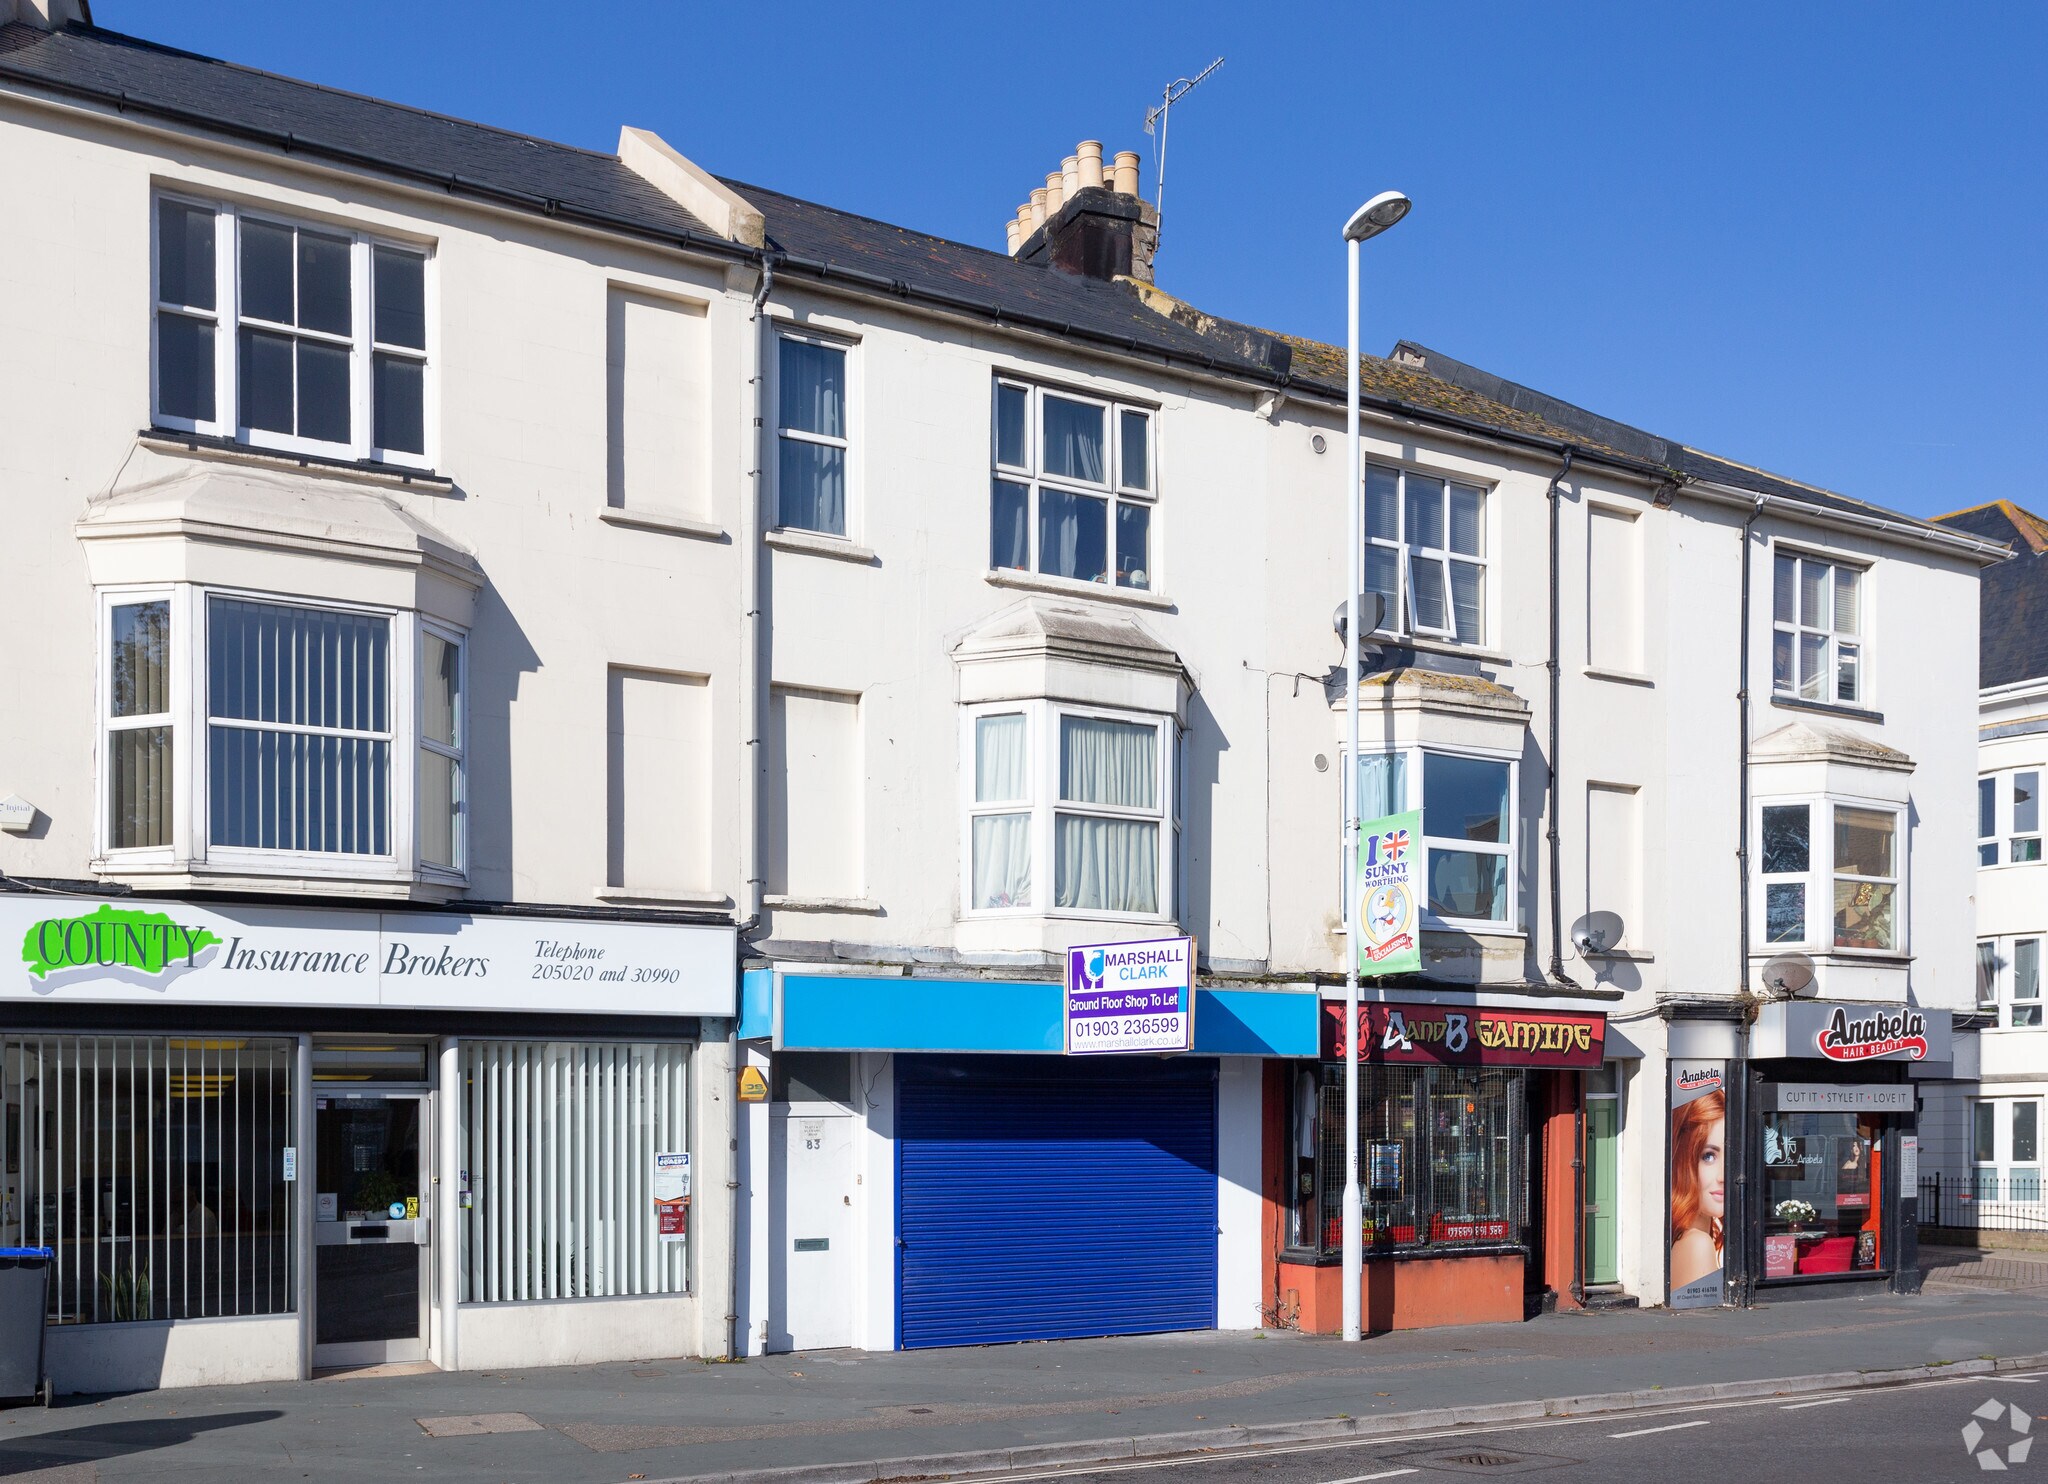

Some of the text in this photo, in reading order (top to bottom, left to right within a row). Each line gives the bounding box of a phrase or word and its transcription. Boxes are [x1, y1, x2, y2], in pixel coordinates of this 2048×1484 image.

[1366, 835, 1380, 867] I
[1365, 861, 1409, 880] SUNNY
[1365, 874, 1409, 888] WORTHING
[38, 919, 490, 978] COUNTY Insurance Brokers
[535, 940, 606, 961] Telephone
[1373, 936, 1407, 960] SOCIALISING
[1105, 949, 1183, 967] MARSHALL
[532, 963, 680, 984] 205020 and 30990
[1120, 965, 1168, 981] CLARK
[1070, 993, 1178, 1011] Ground Floor Shop To Let
[1076, 1017, 1179, 1037] 01903 236599
[1827, 1008, 1925, 1048] Anabela
[1074, 1036, 1183, 1049] www.marshallclark.co.uk
[1475, 1019, 1592, 1054] GAMING
[1843, 1040, 1904, 1058] HAIR BEAUTY
[1680, 1068, 1720, 1084] Anabela
[1786, 1092, 1906, 1103] CUT IT STYLE IT LOVE IT
[806, 1139, 821, 1150] 83
[659, 1157, 688, 1166] COMEDY
[1797, 1153, 1823, 1164] Anabela
